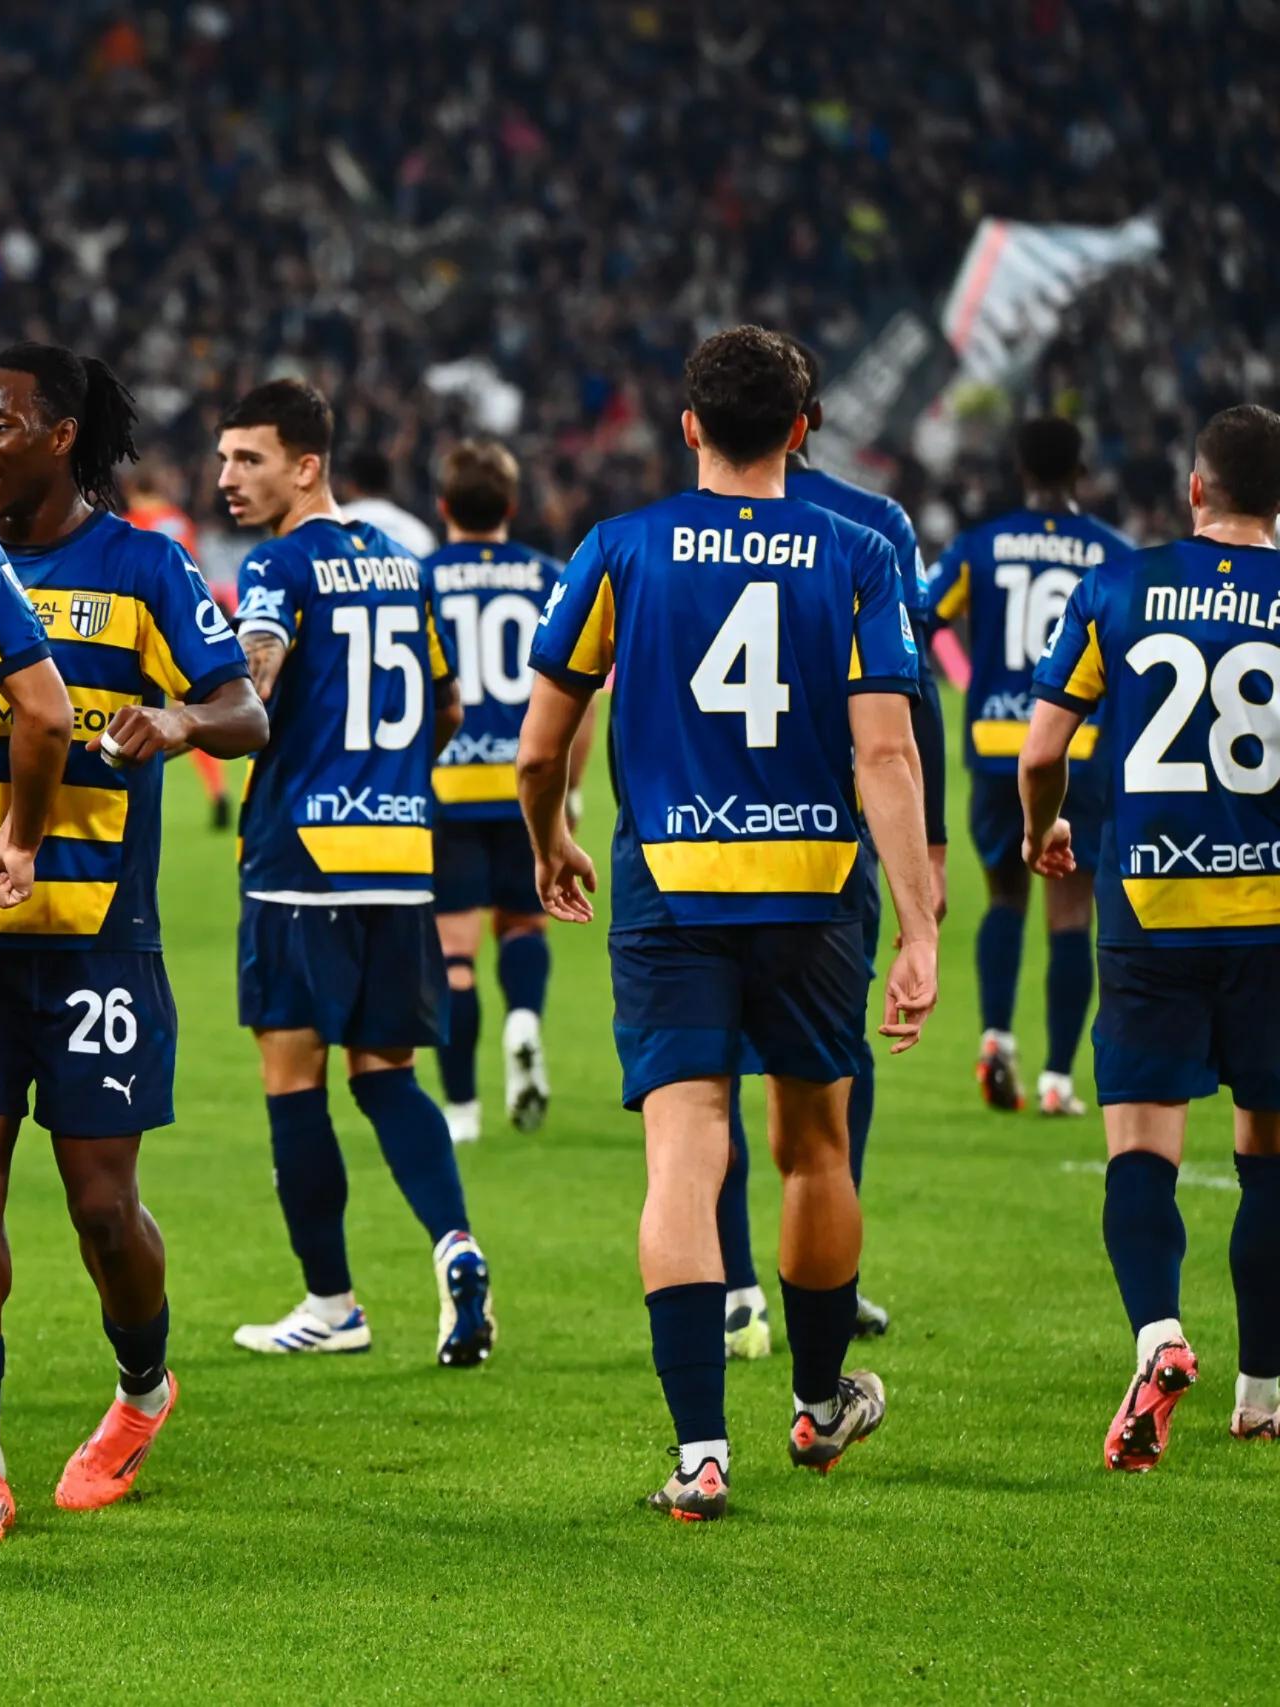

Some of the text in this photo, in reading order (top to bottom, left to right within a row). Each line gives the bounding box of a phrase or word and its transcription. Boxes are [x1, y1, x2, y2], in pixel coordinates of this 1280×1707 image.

[312, 556, 420, 594] DELPRATO
[672, 526, 817, 569] BALOGH
[332, 605, 424, 751] 15
[440, 594, 541, 705] 10
[689, 581, 790, 748] 4
[1124, 633, 1280, 794] 28
[307, 786, 426, 823] inX.aer
[667, 794, 838, 834] inX.aero
[65, 987, 138, 1055] 26
